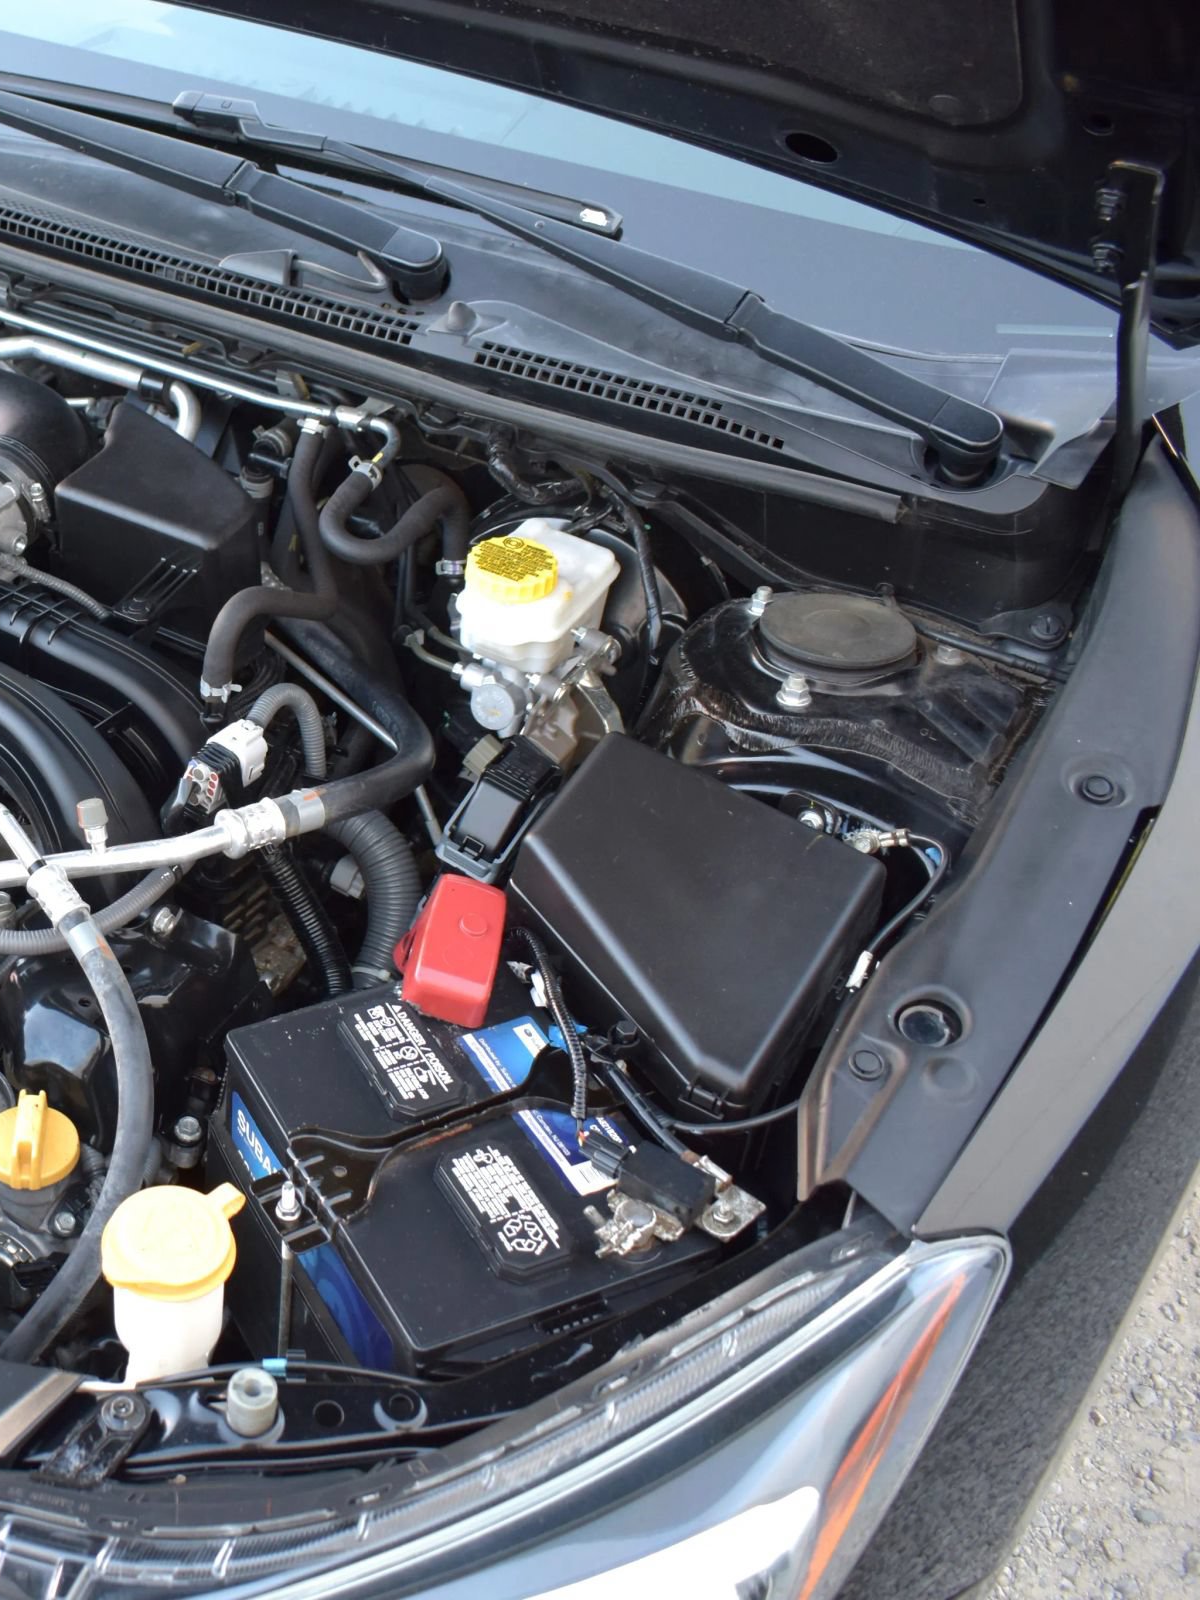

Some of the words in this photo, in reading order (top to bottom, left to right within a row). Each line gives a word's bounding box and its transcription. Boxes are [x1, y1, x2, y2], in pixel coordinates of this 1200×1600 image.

[397, 1011, 427, 1046] DANGER
[424, 1052, 454, 1084] POISON
[237, 1109, 277, 1175] SUBA
